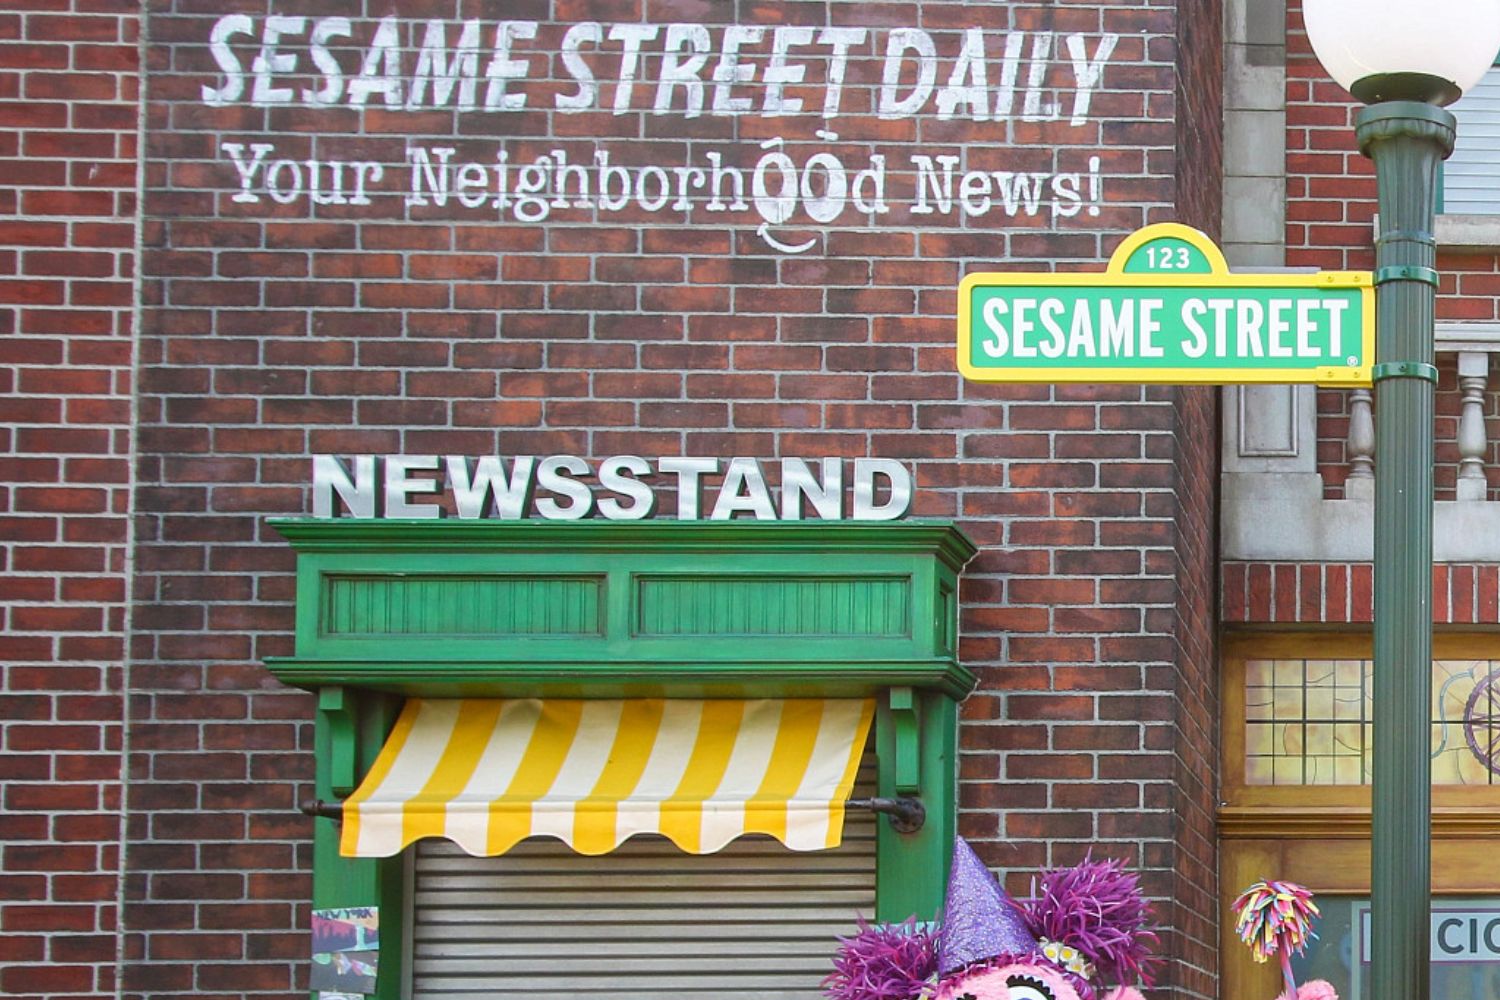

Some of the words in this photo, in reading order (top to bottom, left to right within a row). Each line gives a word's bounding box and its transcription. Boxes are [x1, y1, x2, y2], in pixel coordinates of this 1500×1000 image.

[202, 12, 537, 111] SESAME
[554, 23, 868, 120] STREET
[877, 27, 1119, 127] DAILY
[221, 142, 383, 206] Your
[911, 154, 1104, 218] News!
[1146, 247, 1190, 270] 123
[982, 297, 1165, 359] SESAME
[1180, 298, 1350, 359] STREET
[312, 454, 915, 521] NEWSSTAND
